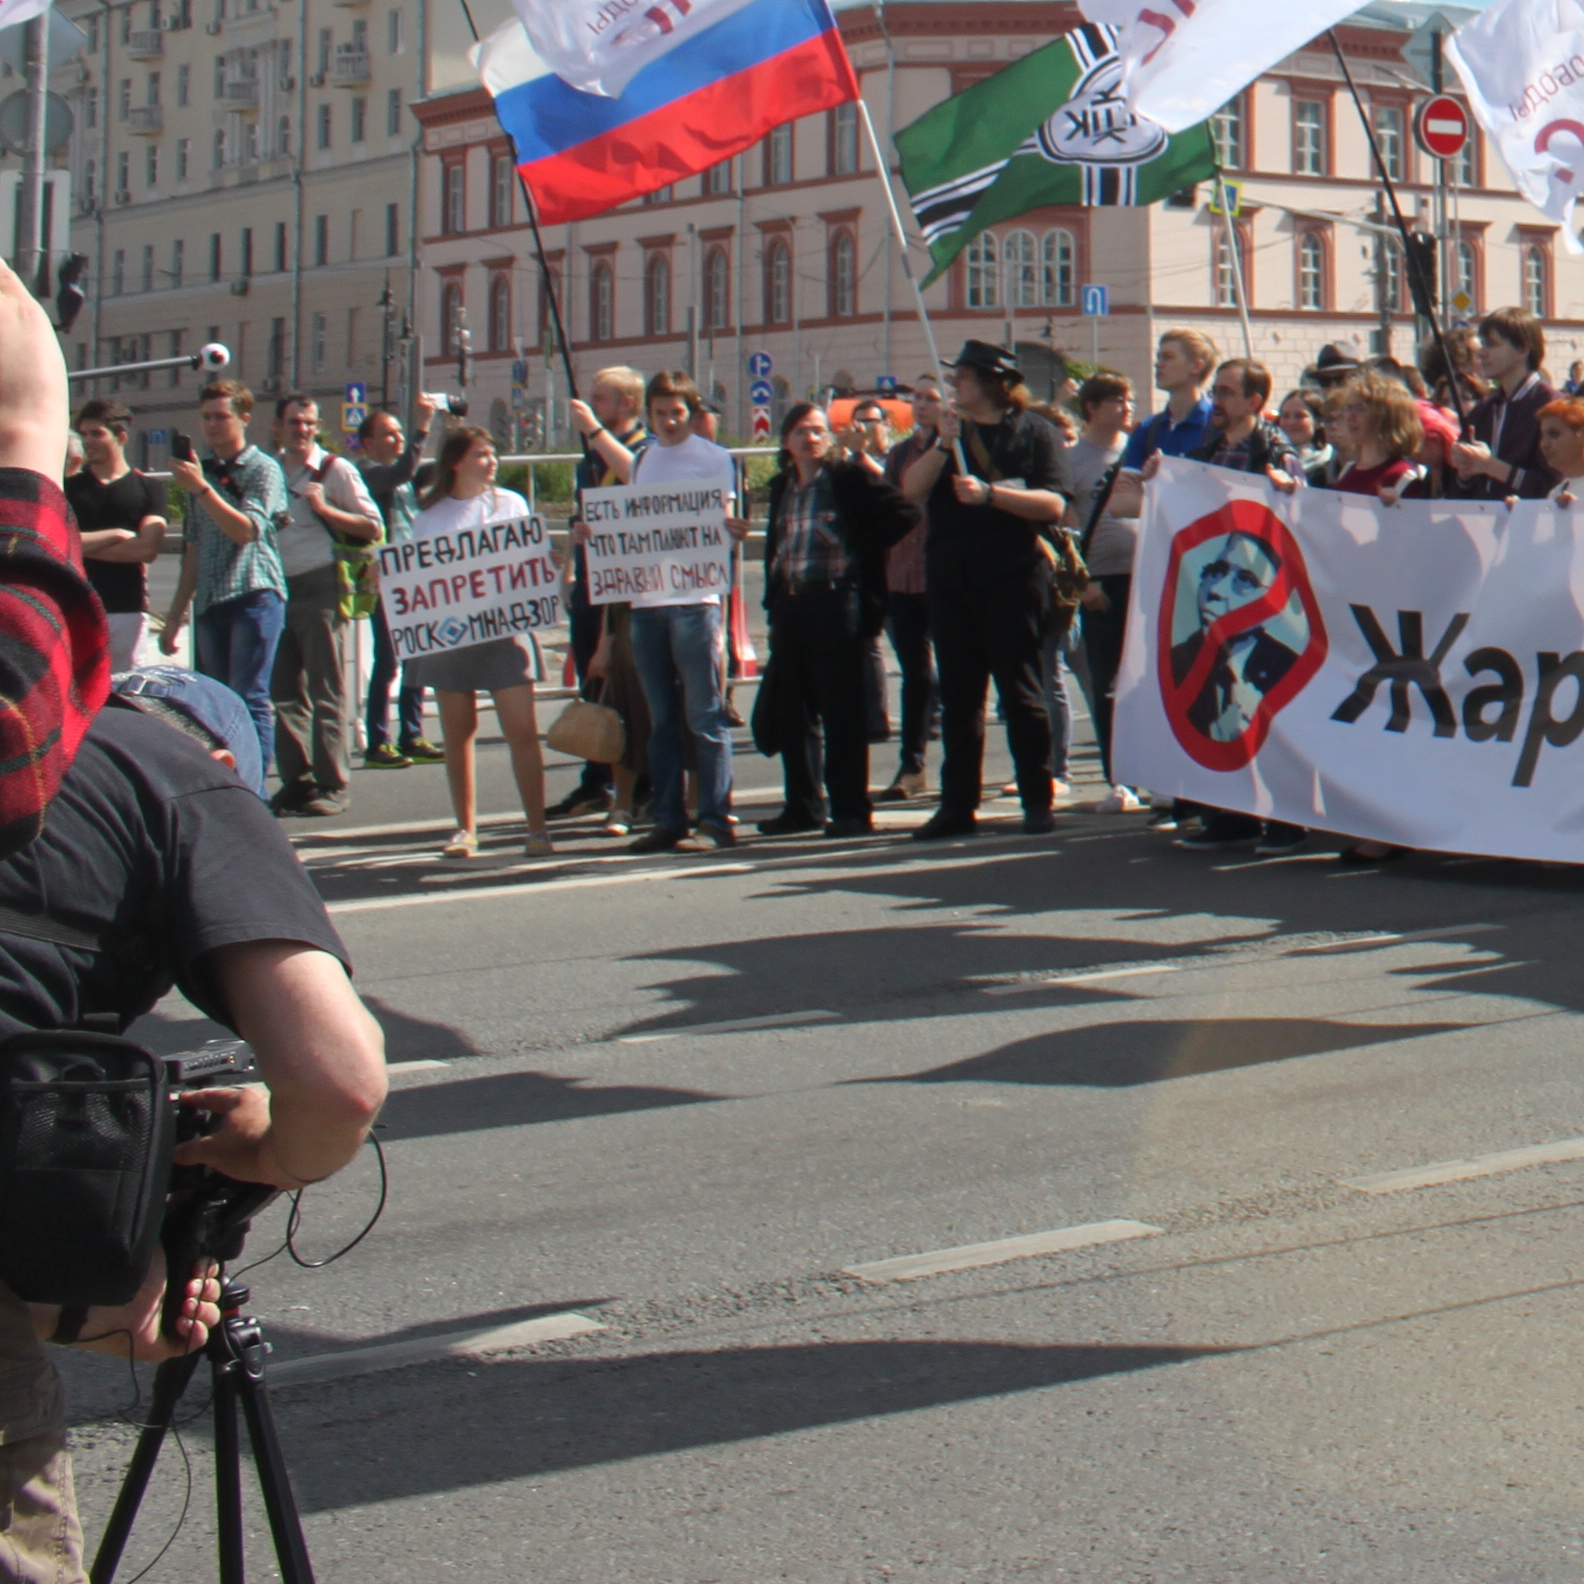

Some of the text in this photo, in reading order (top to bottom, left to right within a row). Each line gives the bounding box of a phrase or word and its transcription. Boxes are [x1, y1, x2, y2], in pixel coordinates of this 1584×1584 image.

[584, 500, 621, 522] ЕСТЬ
[380, 516, 543, 576] ПРЕДЛАГАЮ
[588, 533, 617, 557] ЧТО
[618, 531, 652, 555] ТАМ
[701, 525, 723, 547] НА
[393, 555, 556, 616] ЗАПРЕТИТЬ
[670, 562, 730, 591] СМЫСЛ
